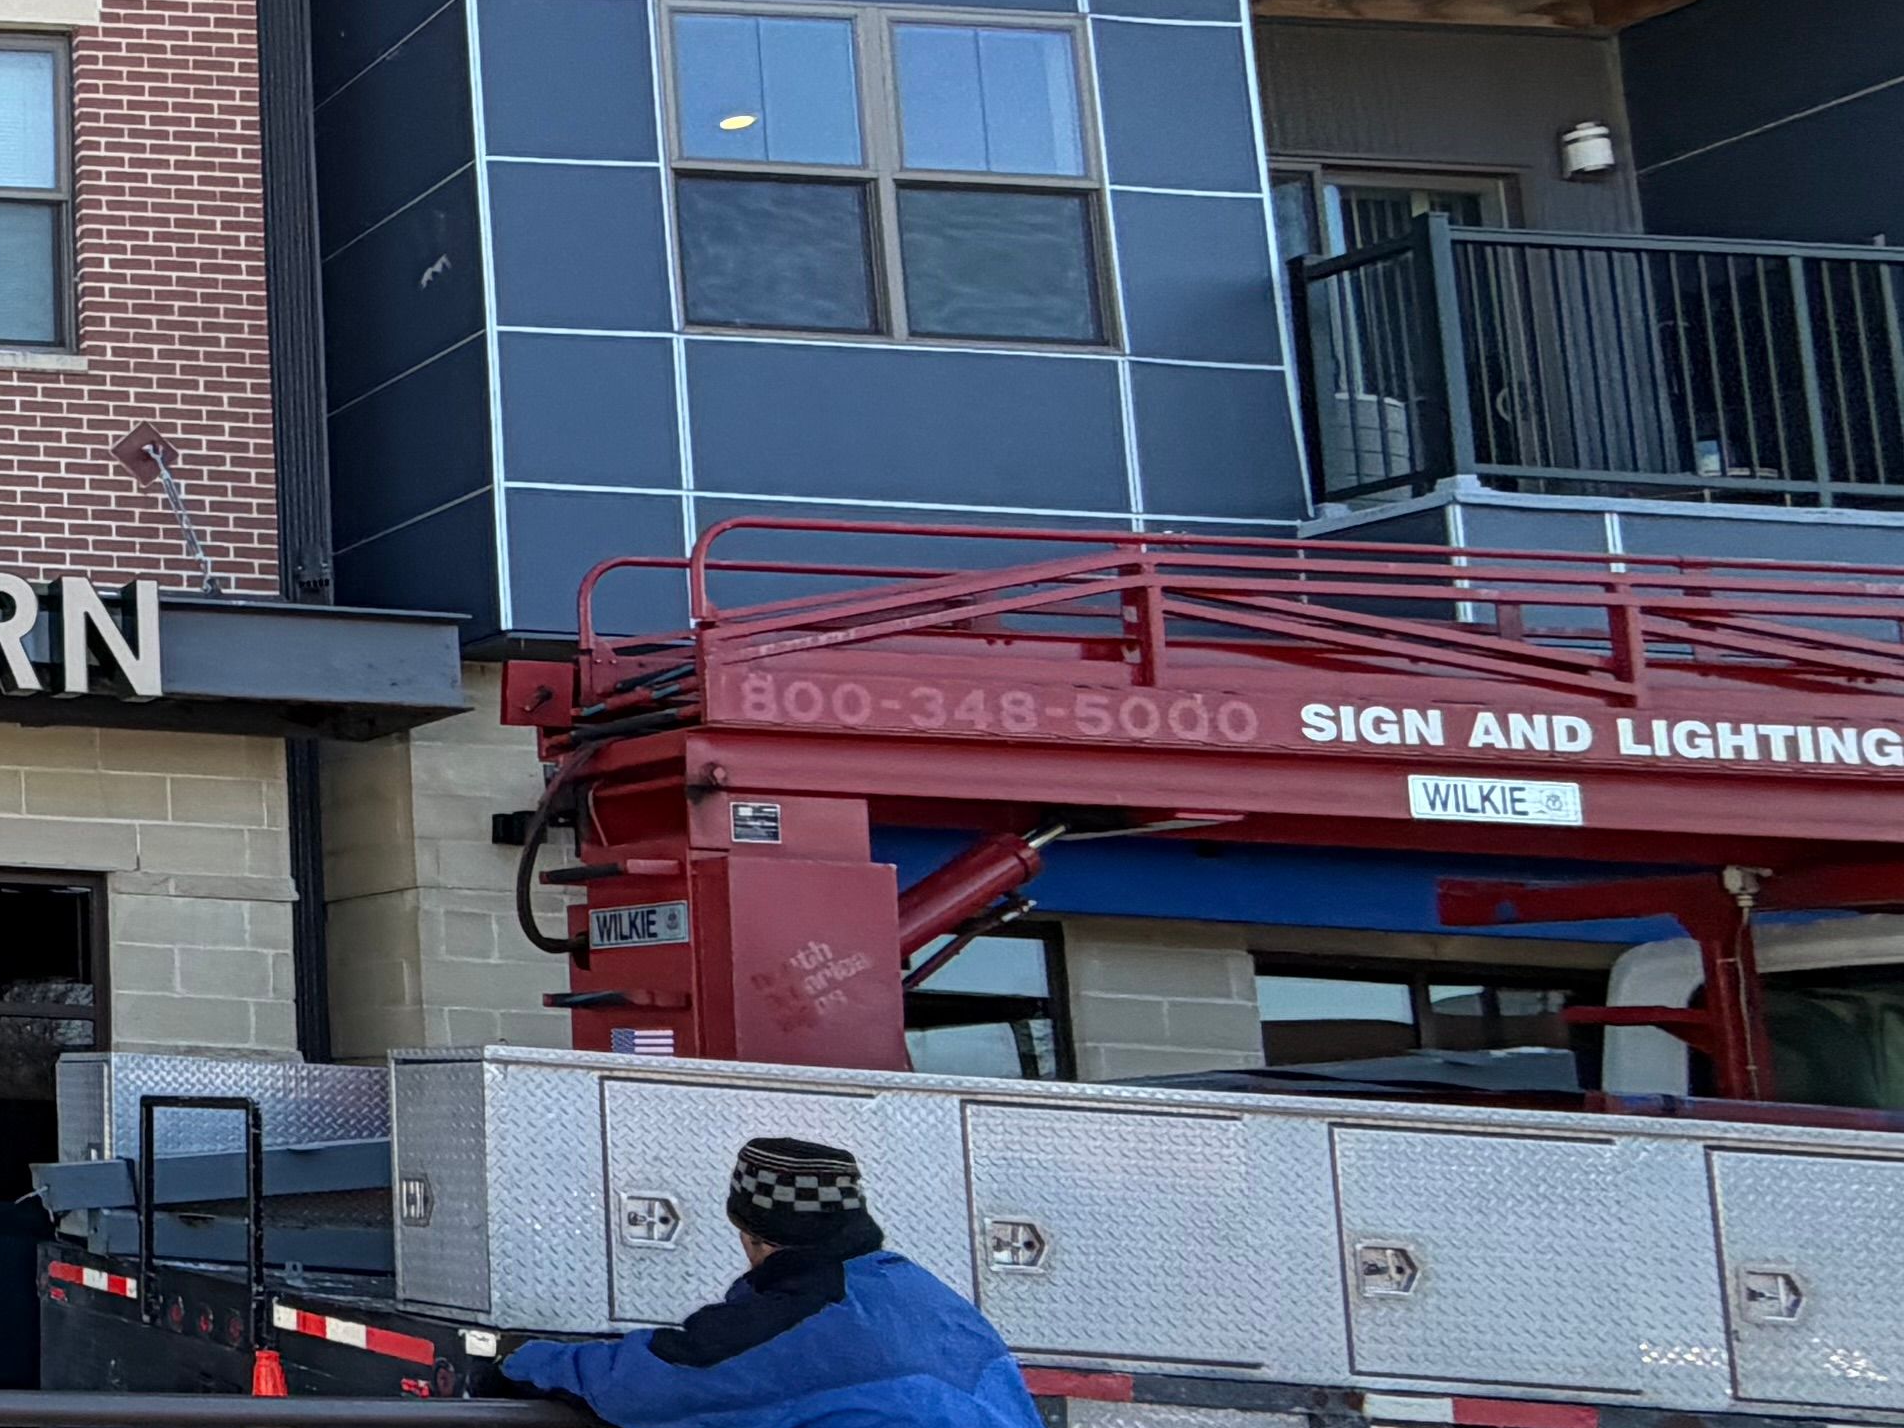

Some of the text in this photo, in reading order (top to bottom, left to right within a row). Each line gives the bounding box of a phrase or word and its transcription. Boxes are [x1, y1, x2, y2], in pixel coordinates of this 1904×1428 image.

[740, 673, 1259, 743] 800-348-5000
[1300, 703, 1904, 767] SIGN AND LIGHTING
[1421, 782, 1530, 816] WILKIE
[595, 909, 658, 943] WILKIE
